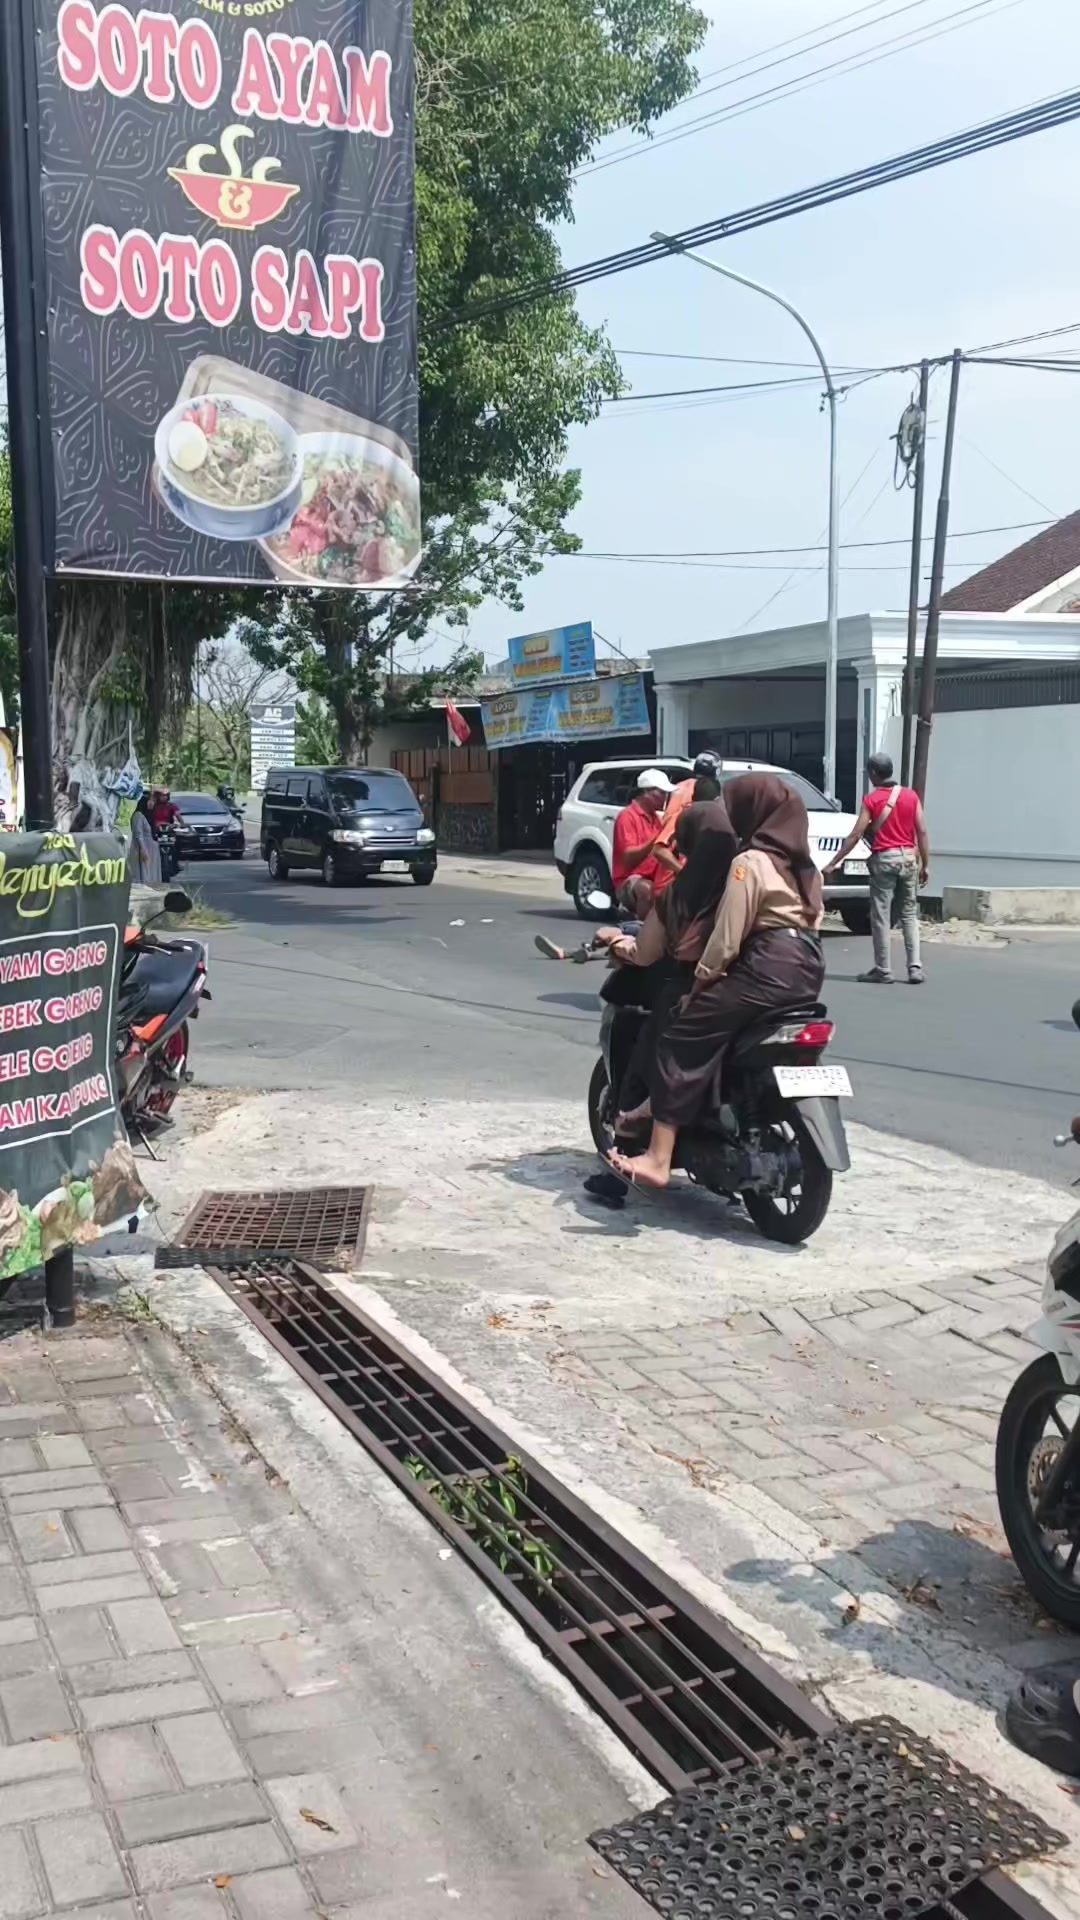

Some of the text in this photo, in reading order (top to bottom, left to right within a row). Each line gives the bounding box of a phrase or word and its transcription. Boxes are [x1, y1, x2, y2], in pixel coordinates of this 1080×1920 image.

[57, 0, 393, 137] SOTO AYAM
[80, 224, 385, 343] SOTO SAPI
